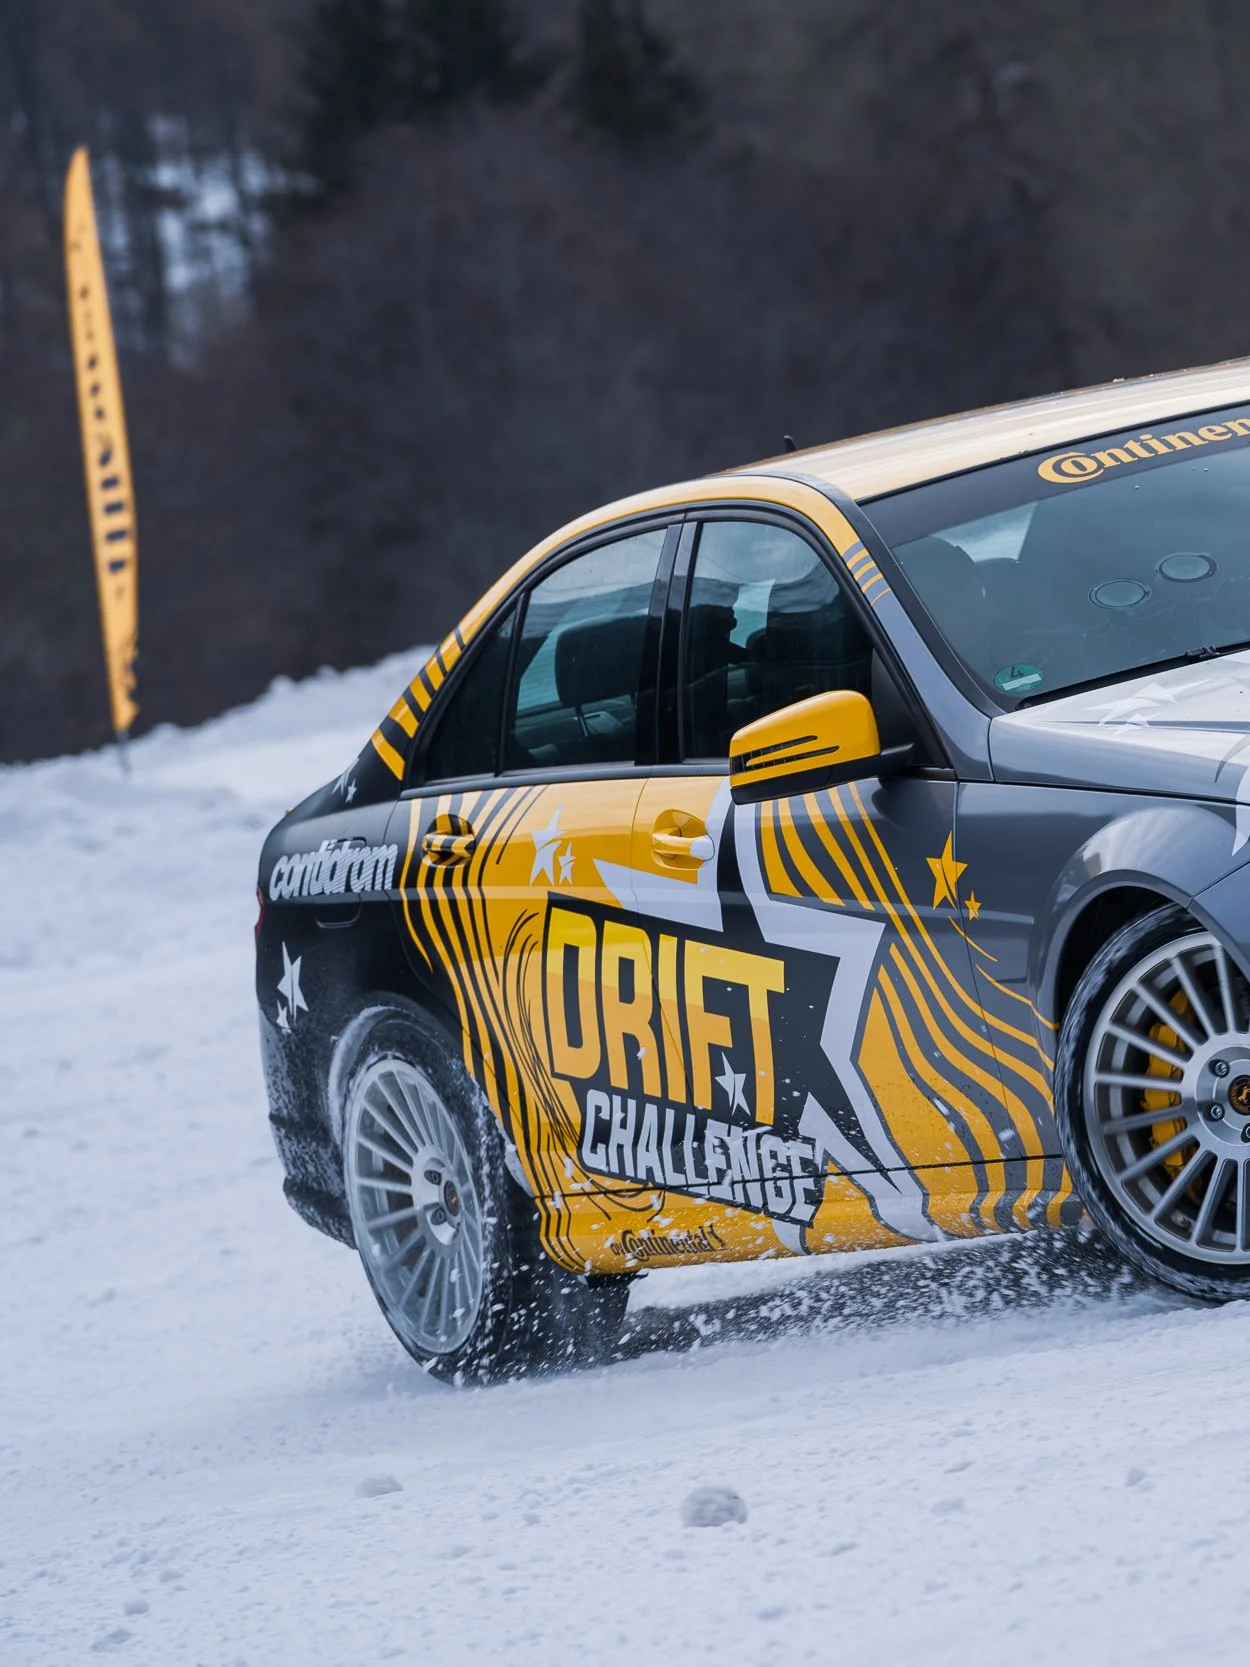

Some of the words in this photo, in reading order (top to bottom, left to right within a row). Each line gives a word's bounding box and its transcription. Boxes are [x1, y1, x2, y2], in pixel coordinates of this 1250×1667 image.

[269, 840, 398, 901] contidrom
[546, 906, 785, 1126] DRIFT
[581, 1088, 816, 1222] CHALLENGE
